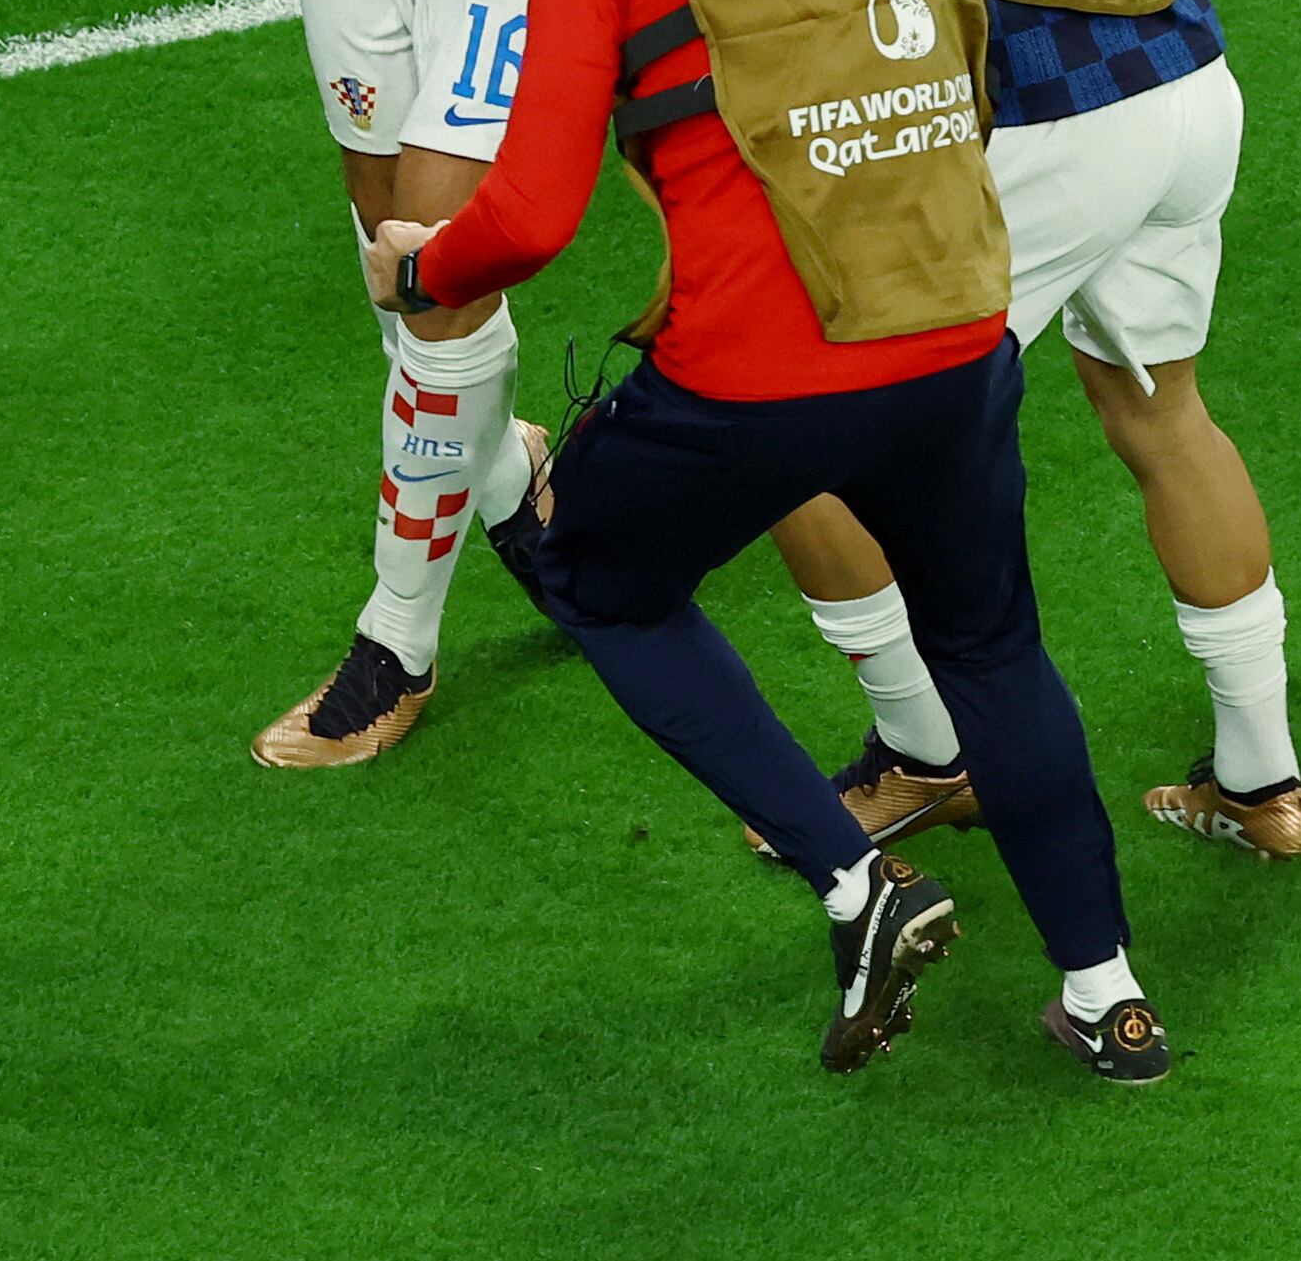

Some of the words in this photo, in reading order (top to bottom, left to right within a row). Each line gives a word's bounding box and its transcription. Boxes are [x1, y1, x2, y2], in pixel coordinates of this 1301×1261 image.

[452, 3, 528, 109] 16
[788, 98, 862, 138] FIFA
[860, 79, 957, 123] WORLD
